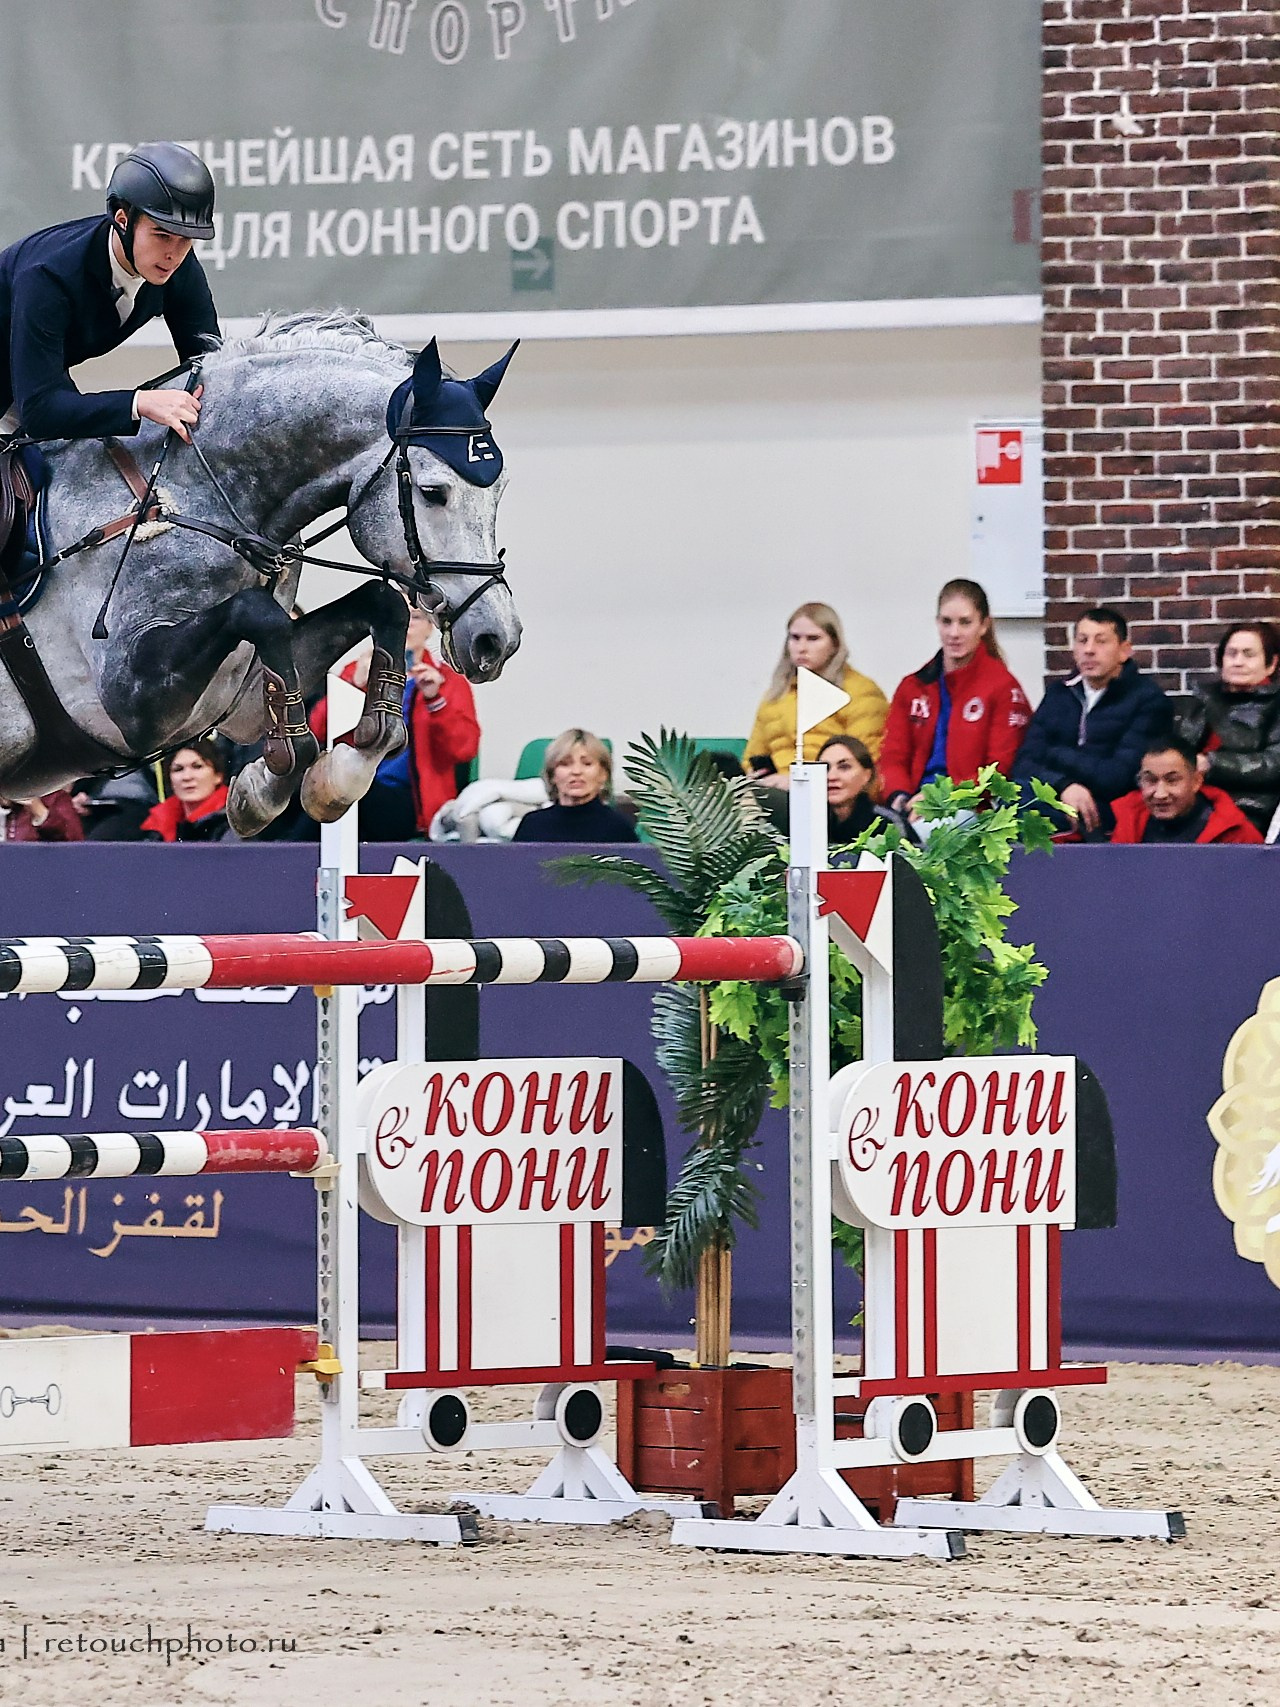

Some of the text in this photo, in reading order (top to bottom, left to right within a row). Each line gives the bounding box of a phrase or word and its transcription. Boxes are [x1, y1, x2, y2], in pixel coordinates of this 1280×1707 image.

[428, 129, 552, 182] СЕТЬ
[568, 115, 896, 176] МАГАЗИНОВ
[306, 202, 540, 258] КОННОГО
[556, 196, 766, 251] СПОРТА
[87, 1189, 224, 1258] لقفز
